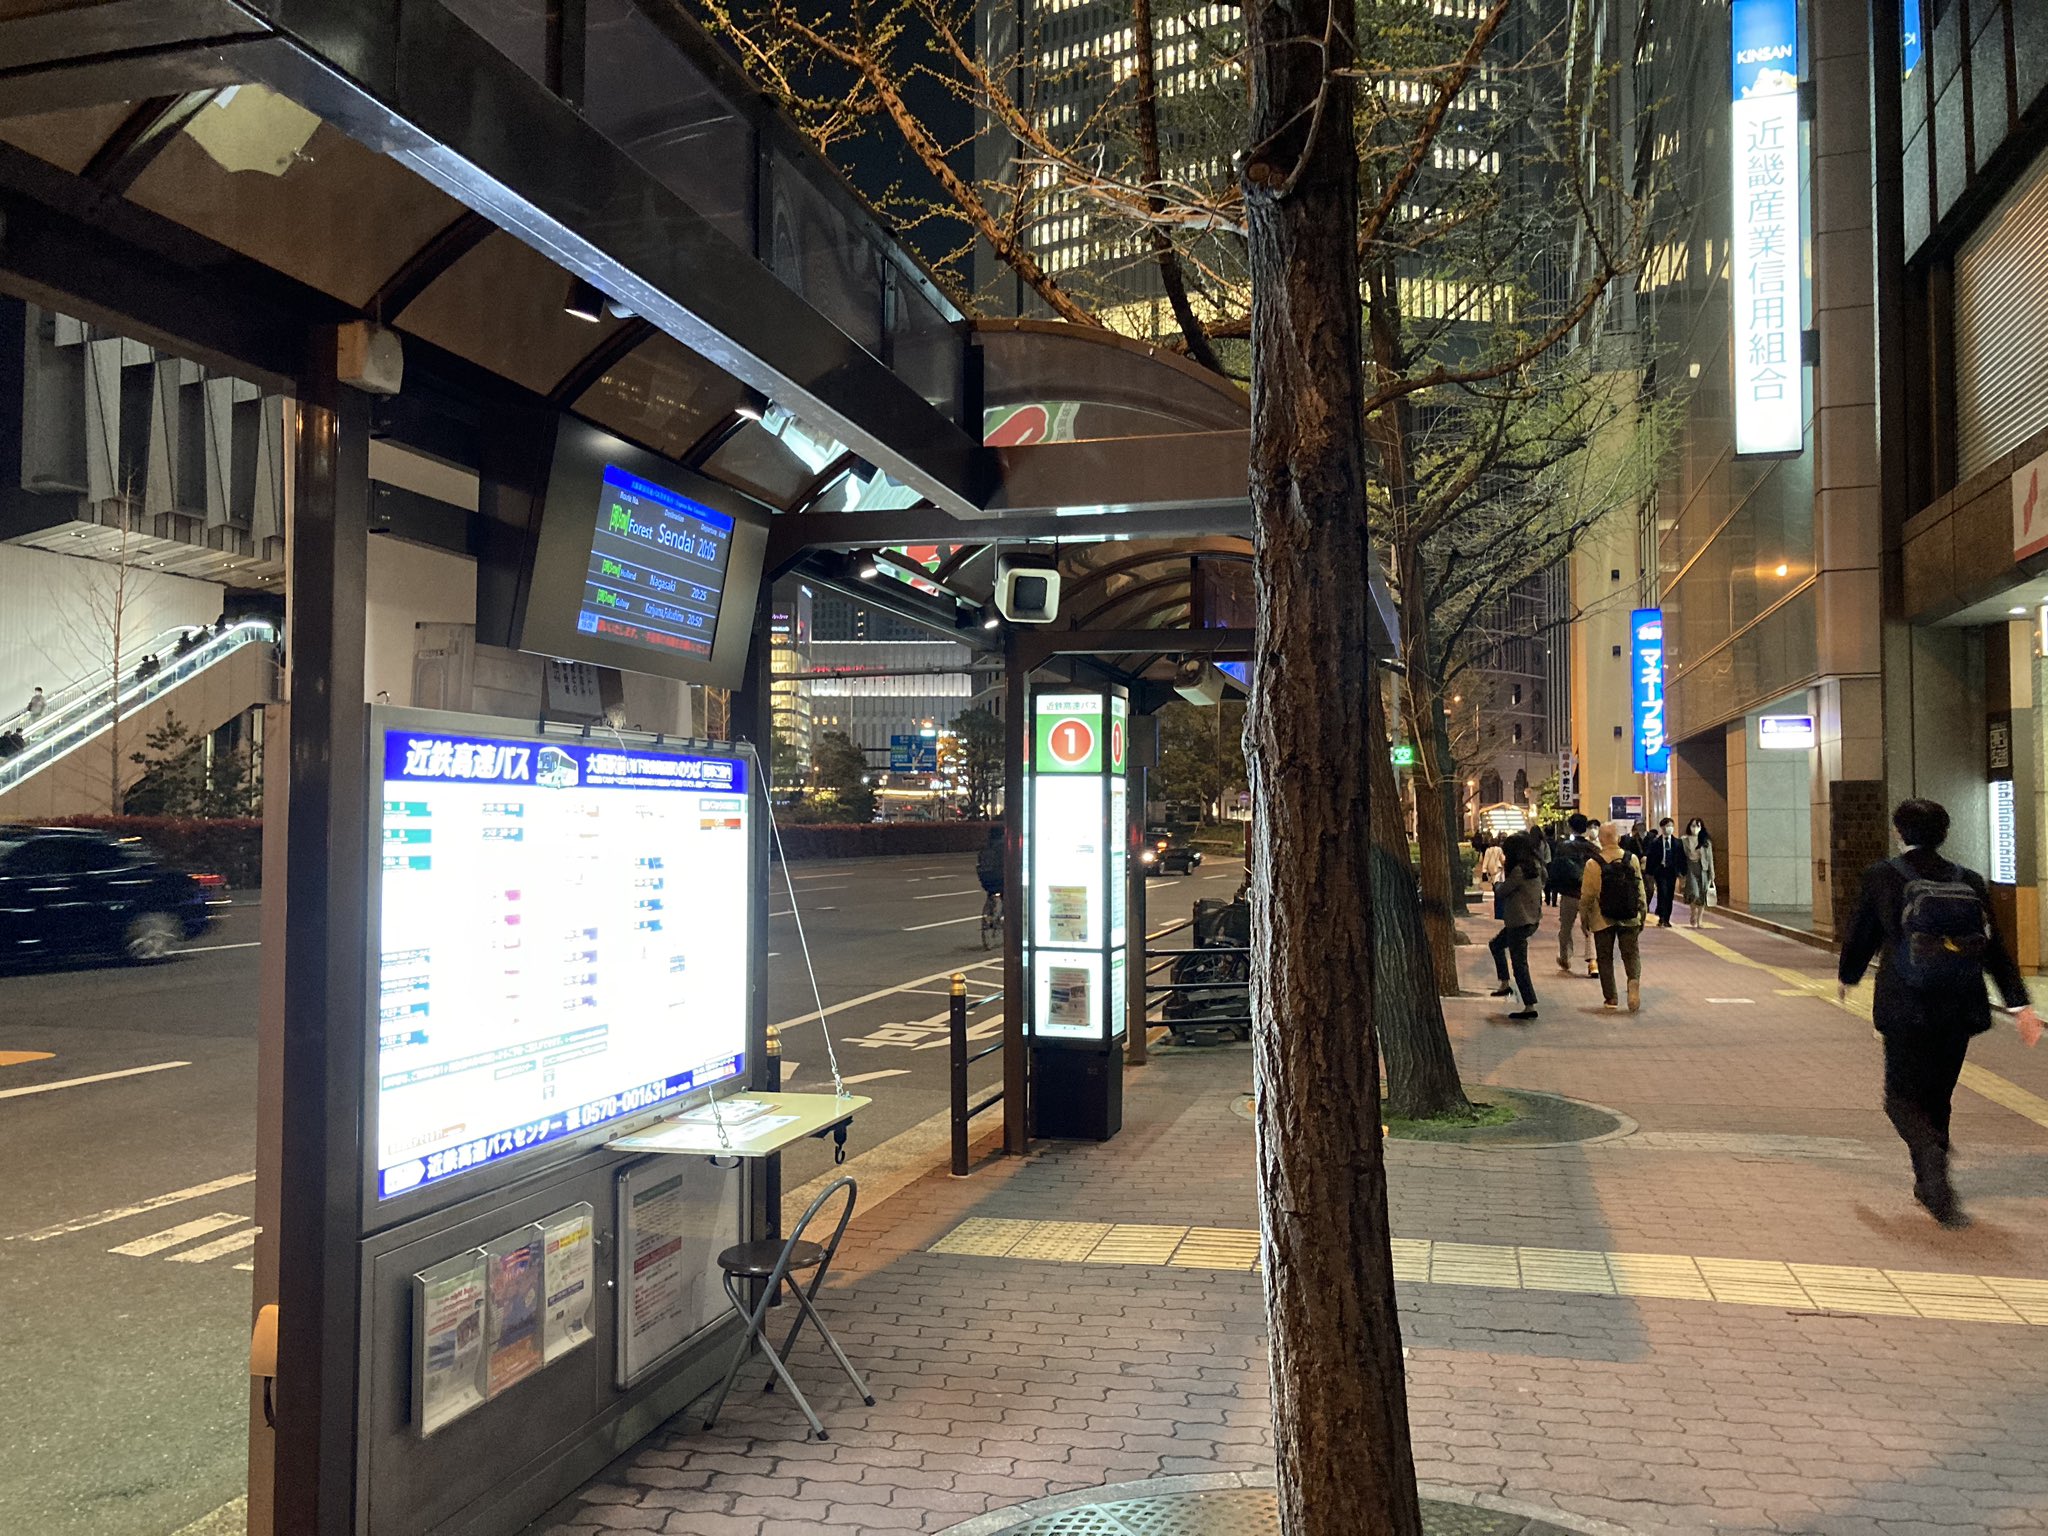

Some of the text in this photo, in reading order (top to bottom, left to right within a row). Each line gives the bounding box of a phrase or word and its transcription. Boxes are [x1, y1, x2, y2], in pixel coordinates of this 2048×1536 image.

[1736, 44, 1793, 65] KINSAN
[1746, 115, 1788, 402] 近畿産業信用組合
[628, 518, 653, 540] Forest
[657, 523, 696, 554] Sendai
[697, 538, 718, 562] 20:05
[649, 575, 677, 592] Nagasaki
[691, 588, 708, 602] 20:25
[686, 614, 703, 628] 20:50
[1063, 728, 1077, 755] 1
[403, 738, 531, 780] 近鉄高速バス
[581, 1078, 667, 1126] 0570-001631
